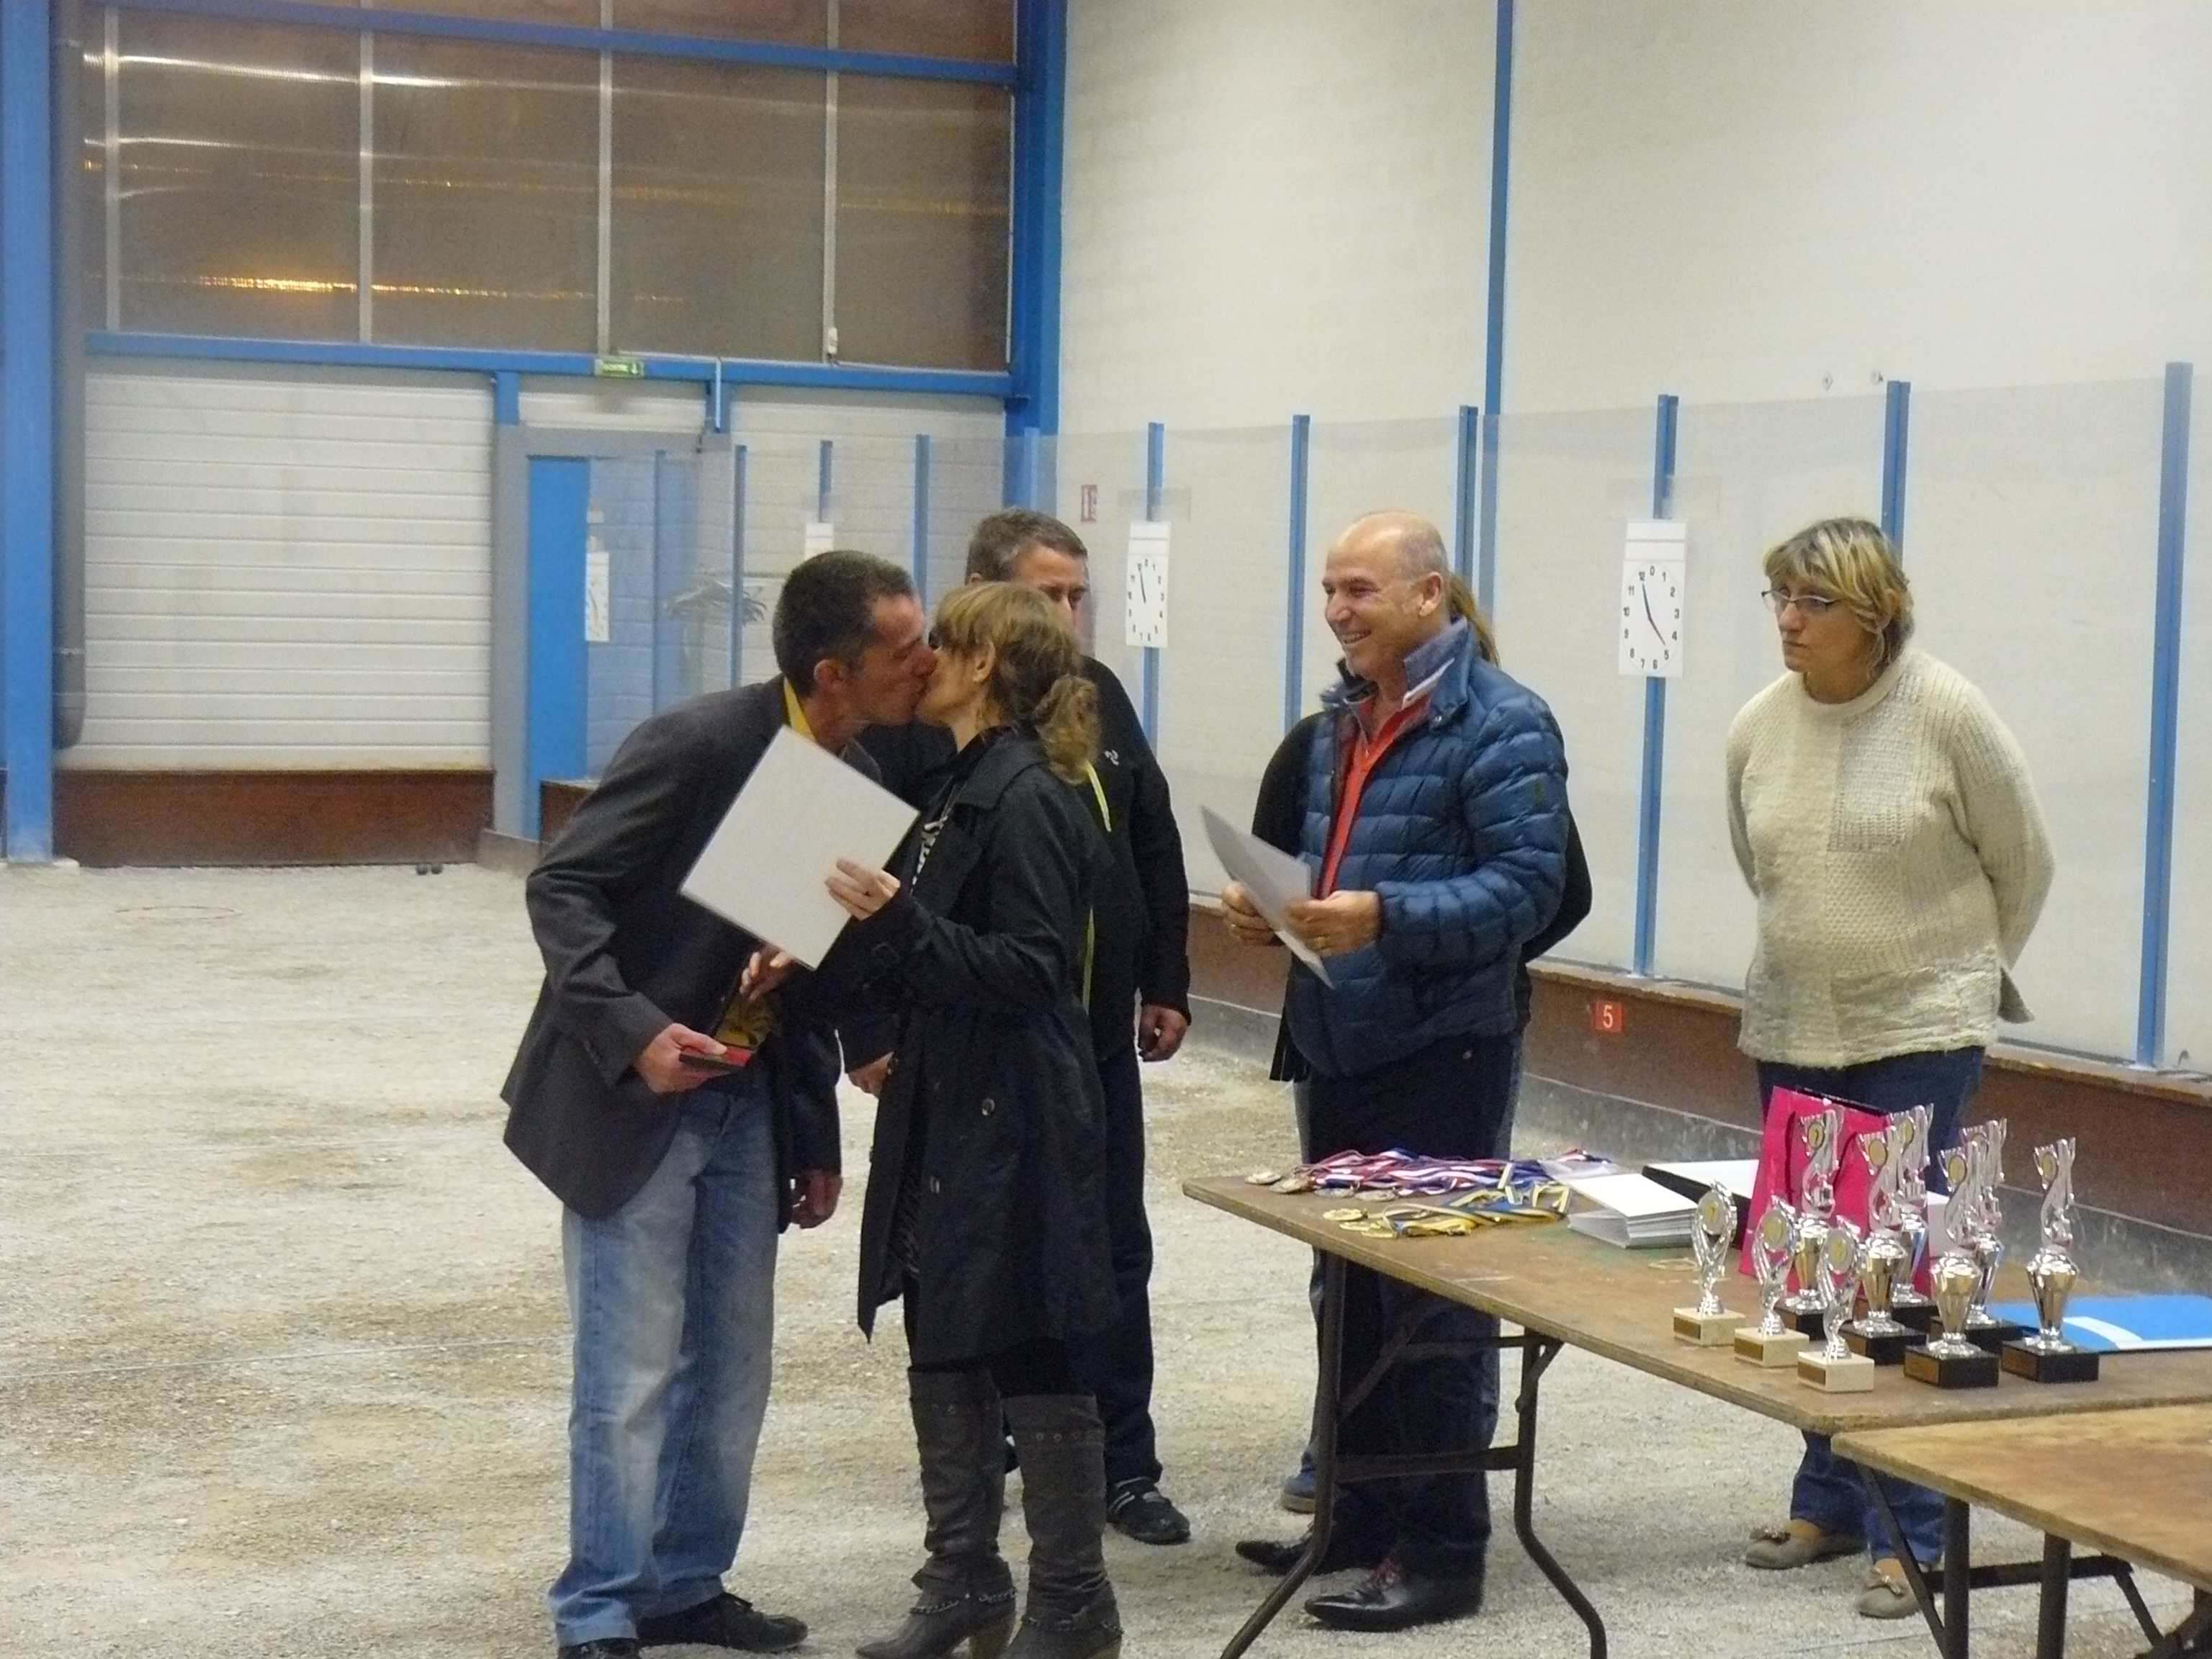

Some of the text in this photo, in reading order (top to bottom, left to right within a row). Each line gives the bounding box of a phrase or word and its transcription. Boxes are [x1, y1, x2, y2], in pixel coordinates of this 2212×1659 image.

[1649, 565, 1655, 576] 0
[1662, 571, 1667, 582] 1
[1670, 586, 1676, 598] 2
[1674, 608, 1680, 619] 3
[1671, 630, 1678, 642] 4
[1663, 649, 1670, 660] 5
[1640, 657, 1645, 669] 7
[1653, 659, 1658, 670] 6
[1602, 1004, 1613, 1029] 5
